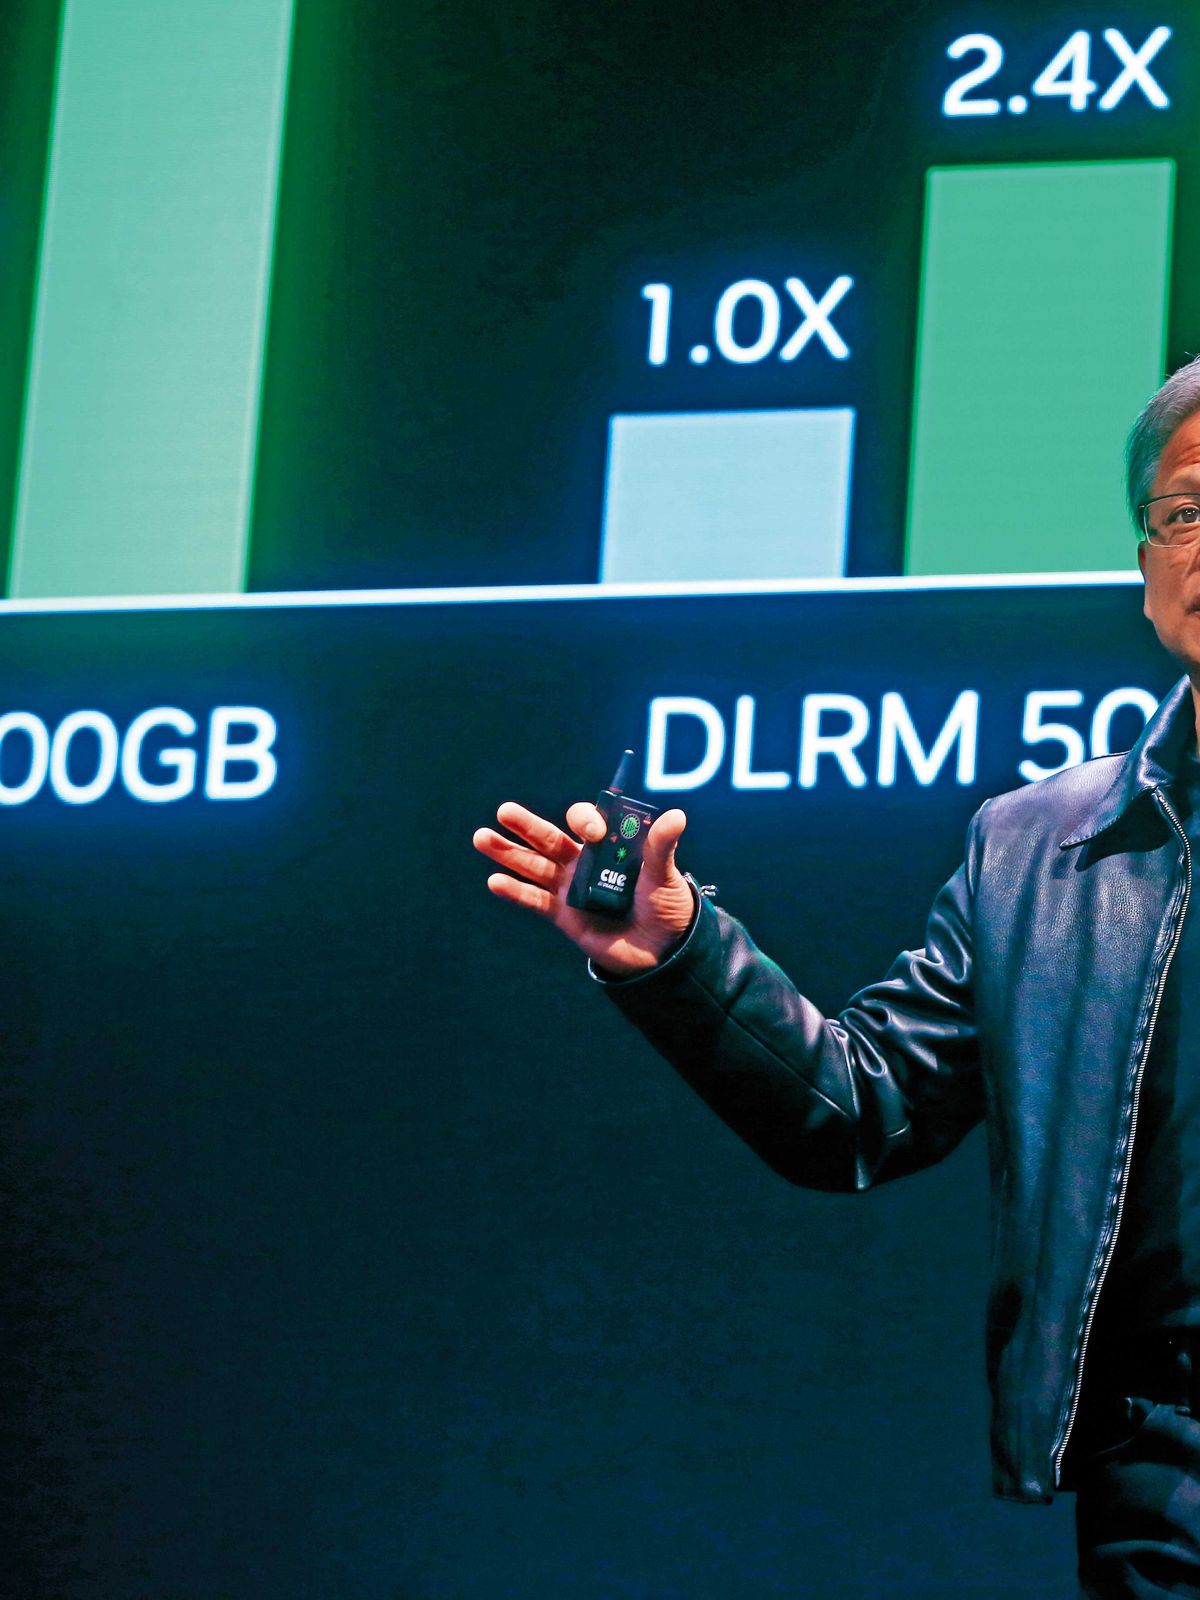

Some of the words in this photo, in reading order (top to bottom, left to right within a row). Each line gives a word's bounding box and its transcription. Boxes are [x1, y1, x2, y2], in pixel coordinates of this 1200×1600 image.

[942, 25, 1172, 117] 2.4X
[642, 275, 854, 366] 1.0X
[645, 689, 980, 791] DLRM
